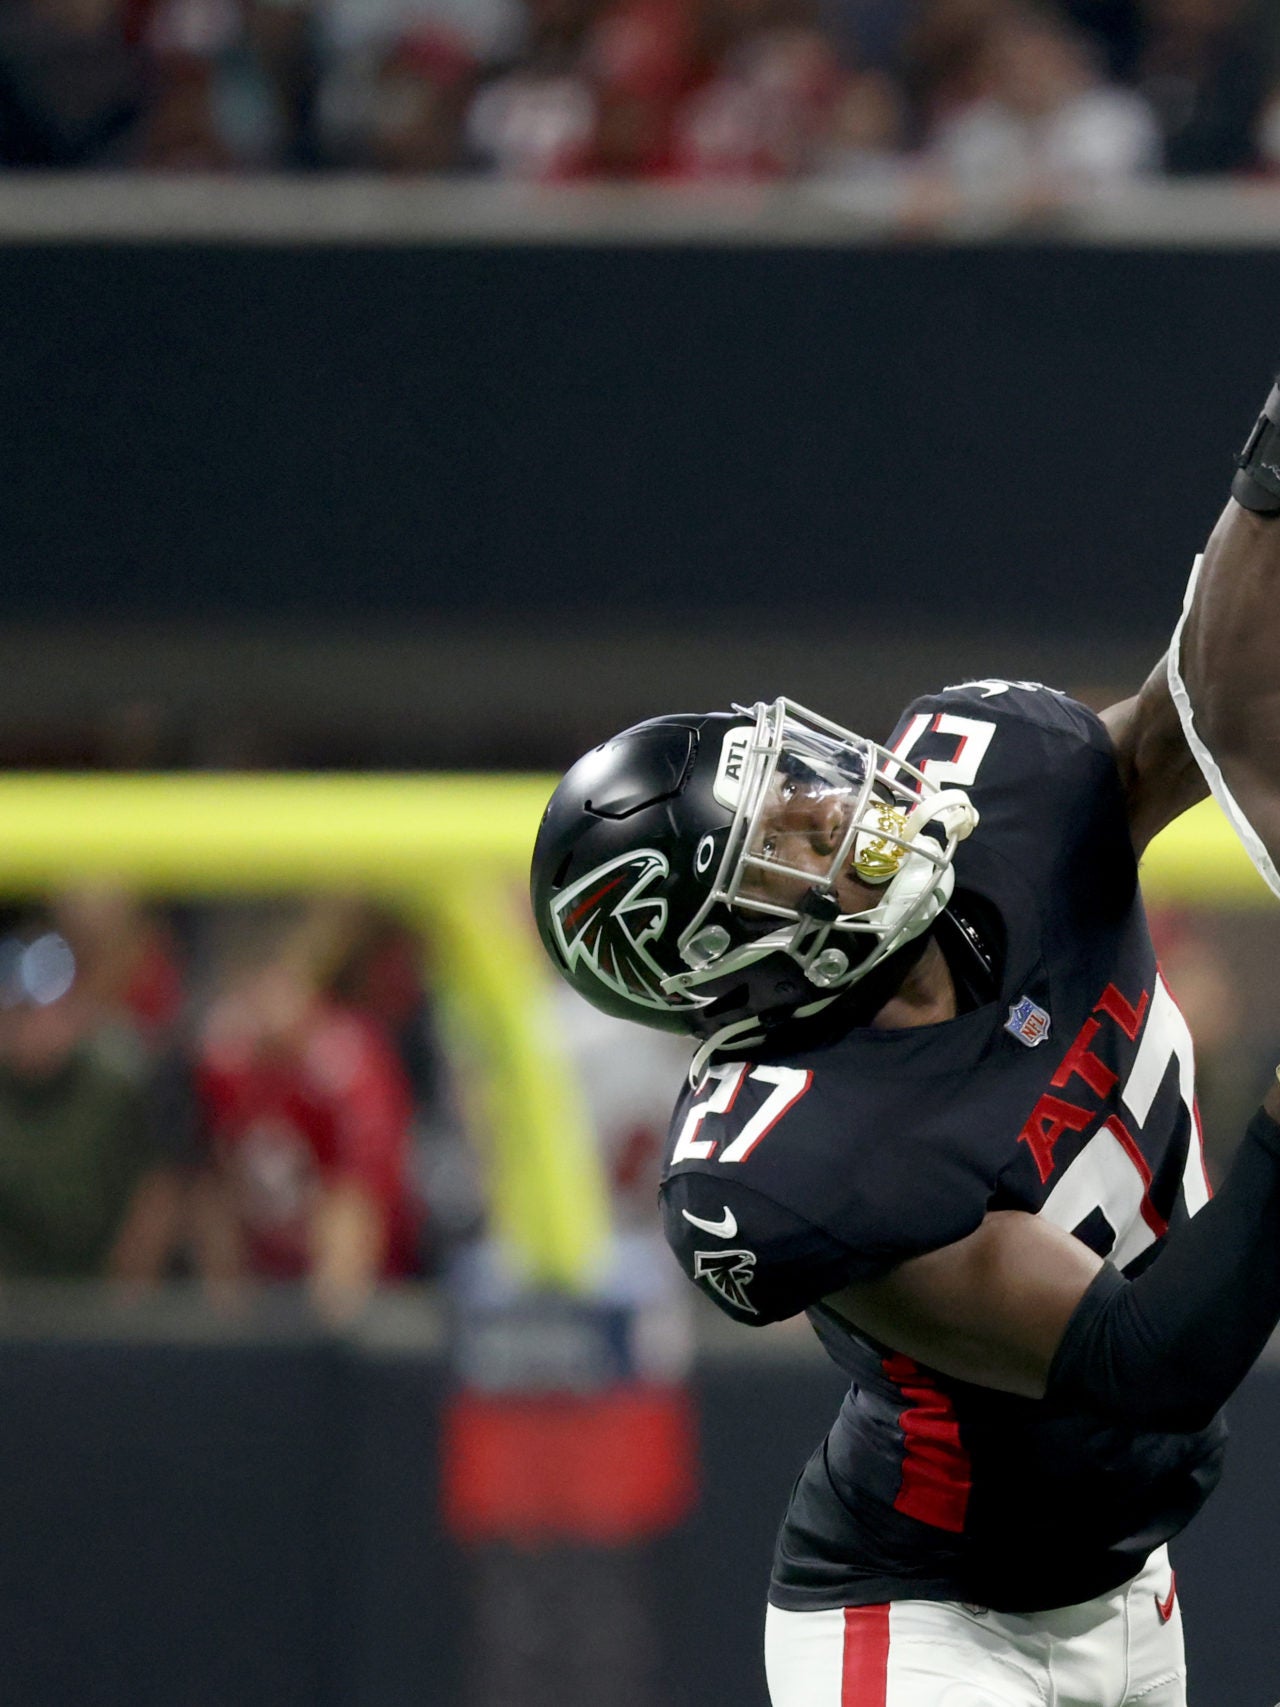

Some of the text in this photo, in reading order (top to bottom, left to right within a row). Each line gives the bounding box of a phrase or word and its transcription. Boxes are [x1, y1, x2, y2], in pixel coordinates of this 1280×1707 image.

[725, 740, 748, 781] ATL
[1021, 1014, 1045, 1040] NFL
[670, 1062, 814, 1165] 27
[1017, 982, 1149, 1184] ATL
